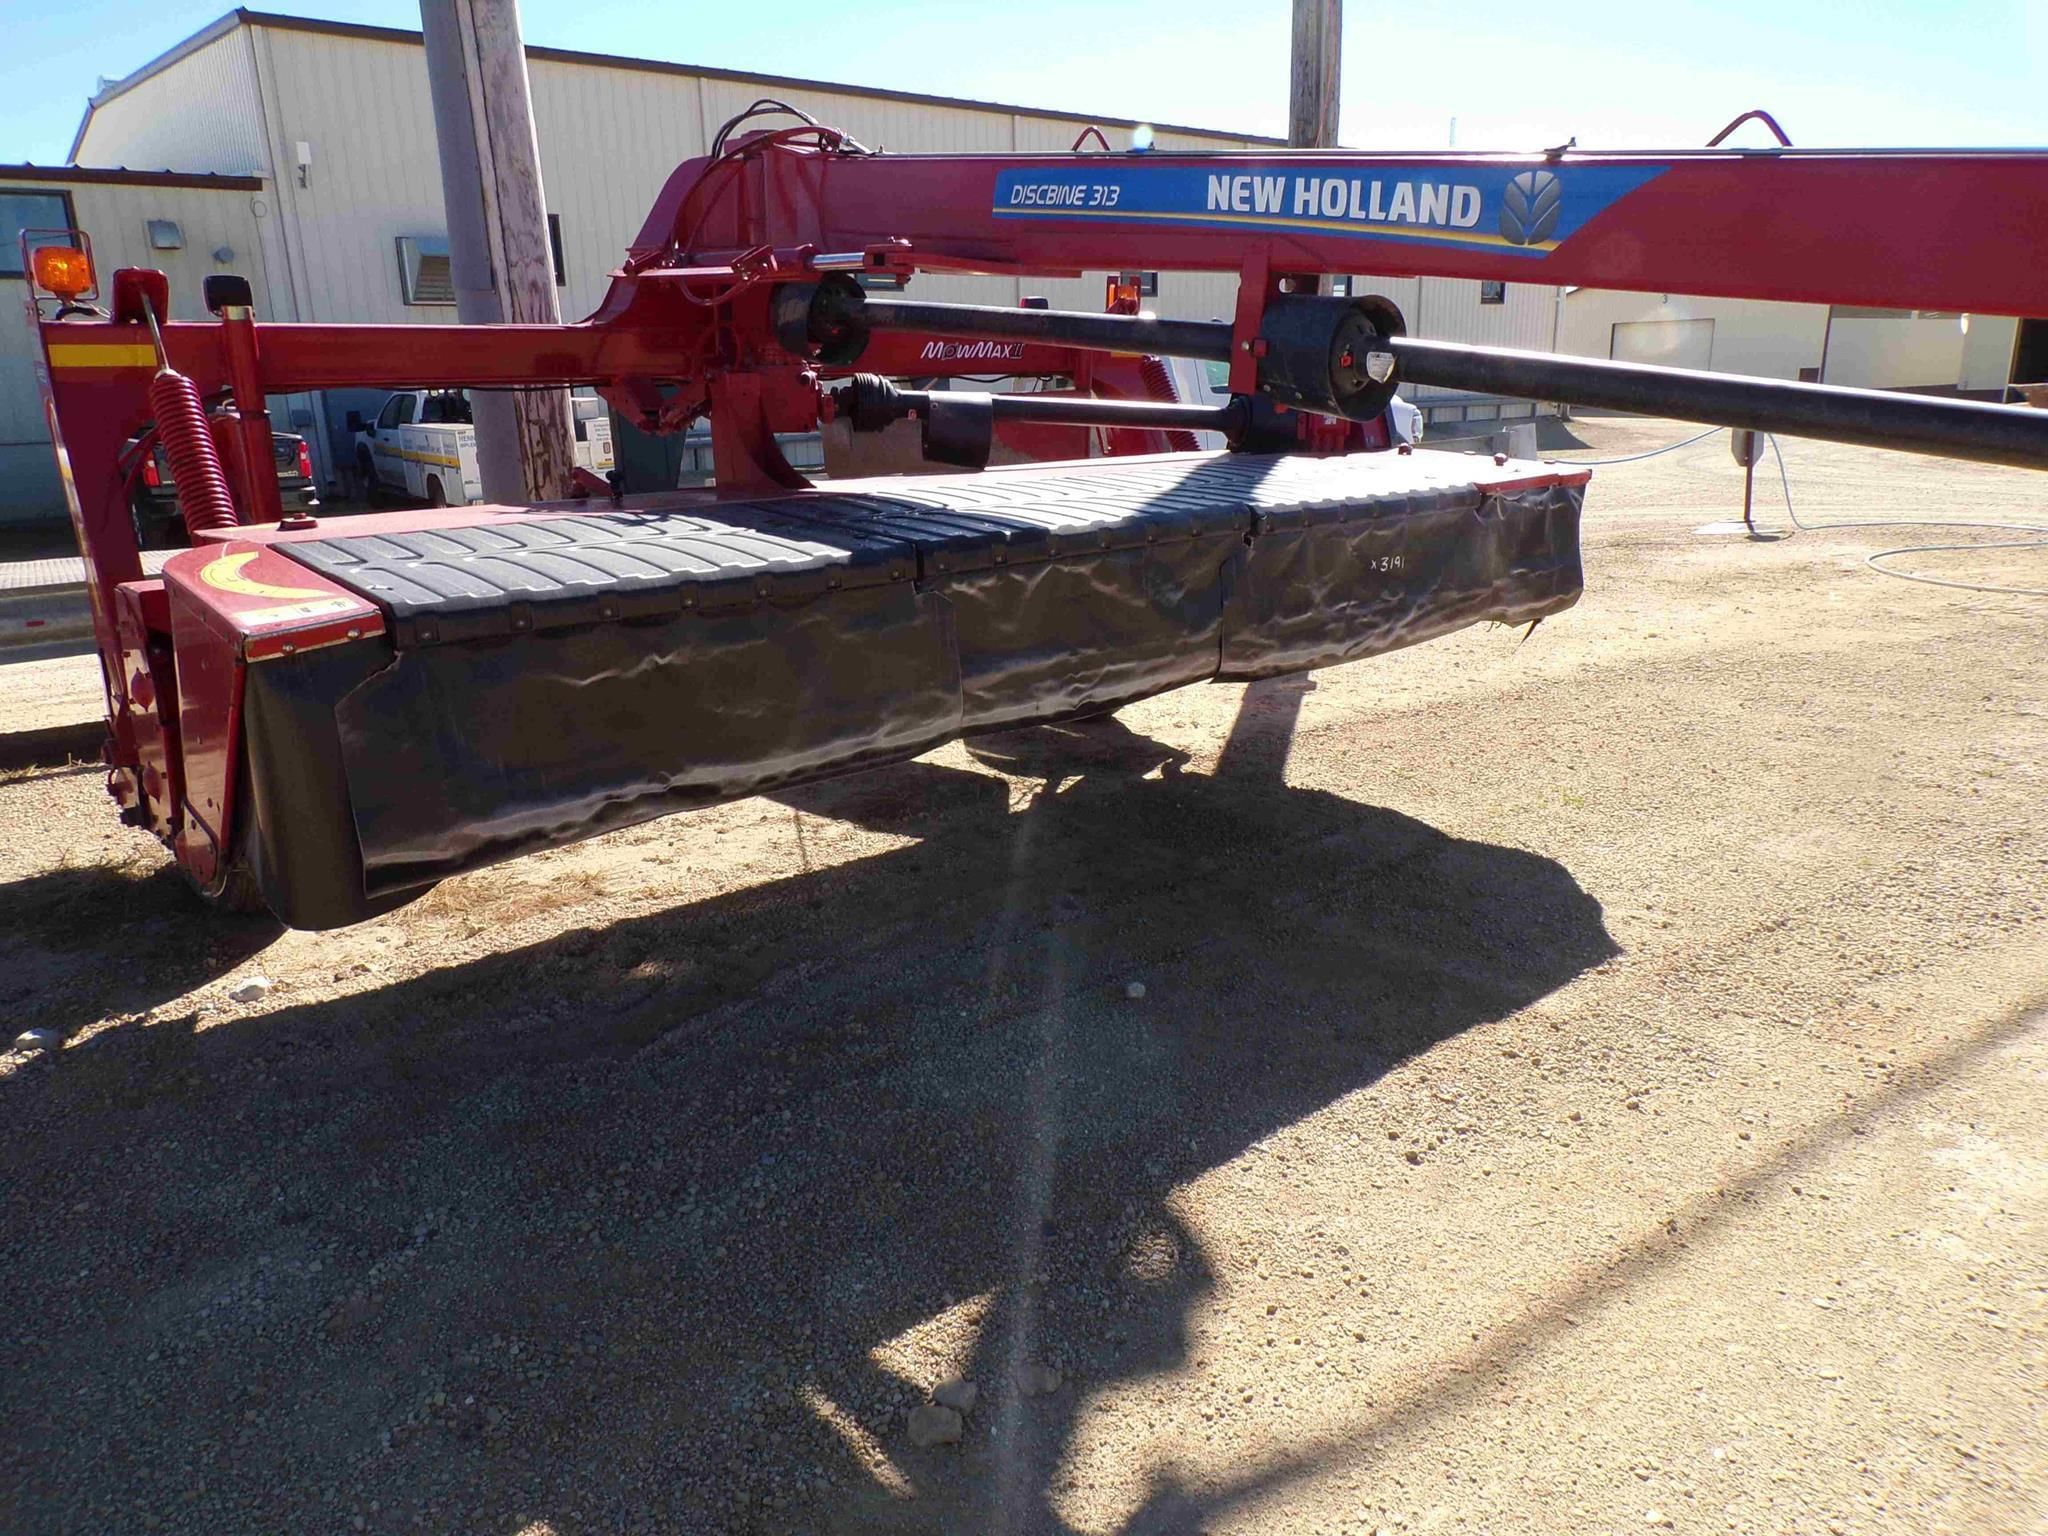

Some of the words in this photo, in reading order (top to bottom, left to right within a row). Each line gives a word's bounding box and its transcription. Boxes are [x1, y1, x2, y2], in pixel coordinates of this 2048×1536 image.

[1010, 185, 1087, 205] DISCBINE
[1088, 185, 1120, 206] 313
[1207, 174, 1286, 213] NEW
[1293, 177, 1482, 228] HOLLAND
[1380, 556, 1405, 572] 3191
